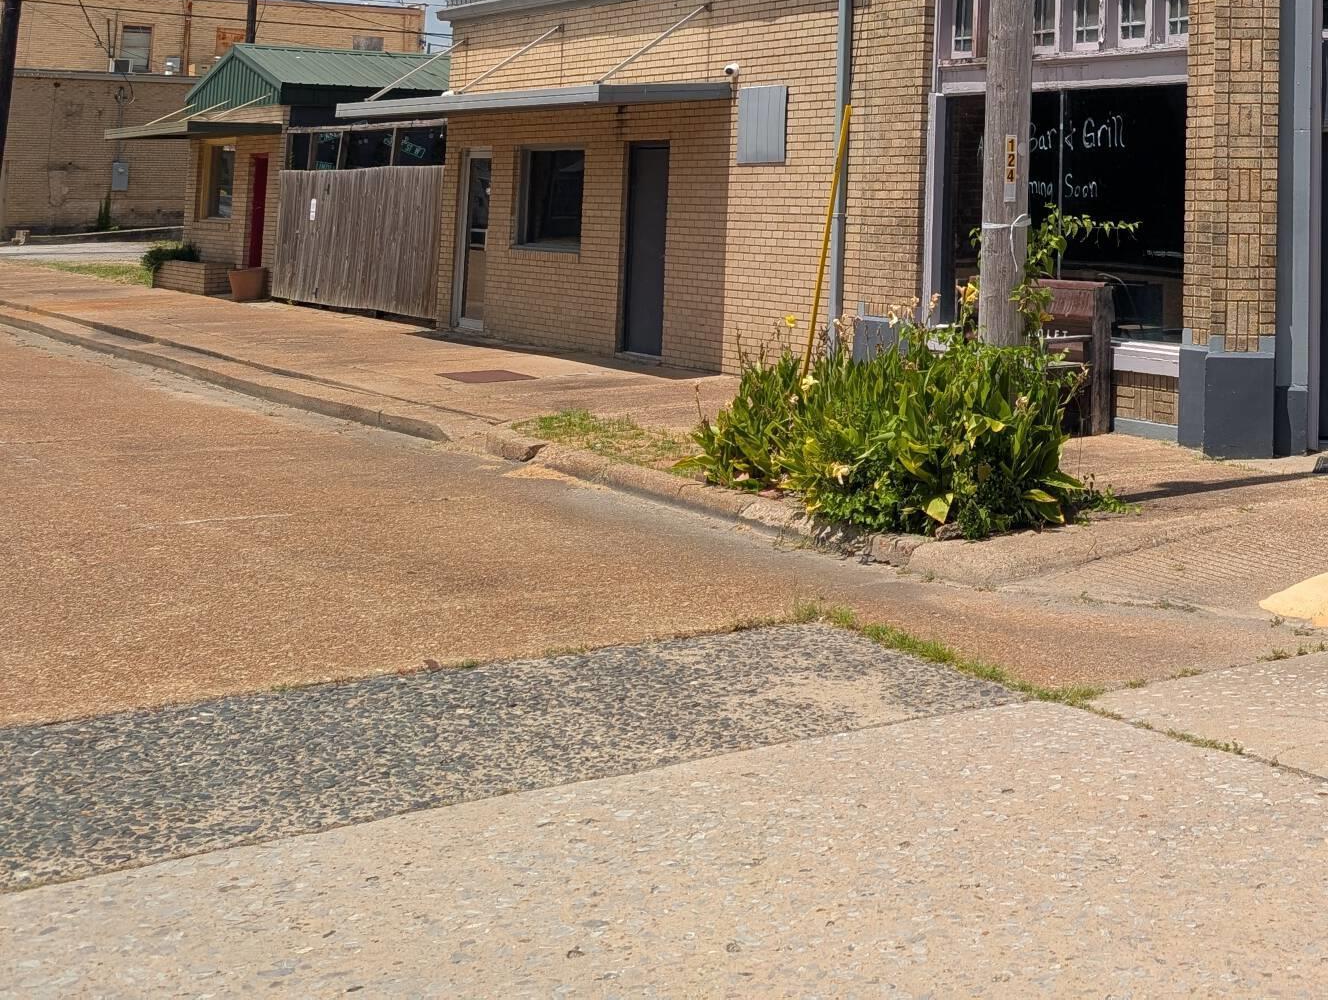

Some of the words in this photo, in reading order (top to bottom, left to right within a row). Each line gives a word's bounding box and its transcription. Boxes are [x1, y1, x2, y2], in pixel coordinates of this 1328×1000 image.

[1082, 113, 1126, 149] Grill
[1007, 139, 1016, 183] 124
[1064, 173, 1099, 199] Soon
